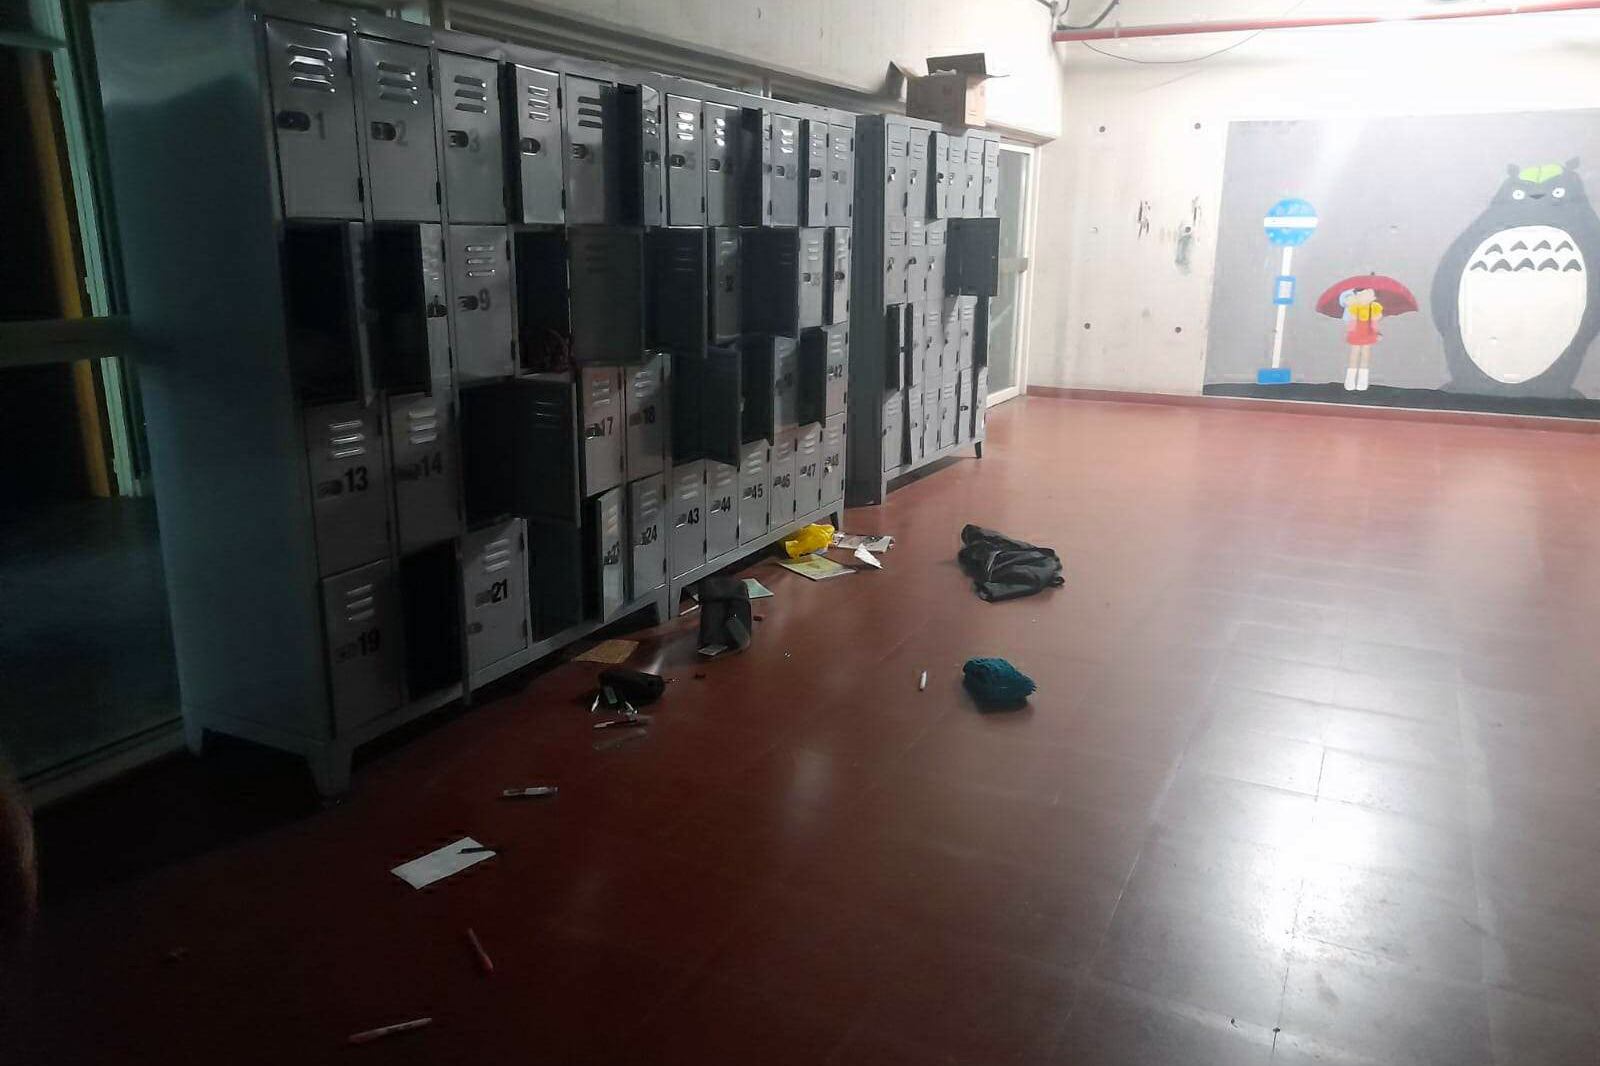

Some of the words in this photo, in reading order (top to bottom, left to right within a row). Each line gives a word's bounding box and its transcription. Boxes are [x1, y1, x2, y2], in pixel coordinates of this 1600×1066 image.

[315, 111, 326, 140] 1
[396, 119, 408, 147] 2
[479, 287, 491, 311] 9
[833, 364, 843, 379] 42
[642, 405, 656, 426] 18
[600, 416, 614, 437] 17
[421, 451, 444, 479] 14
[806, 463, 816, 478] 47
[344, 464, 369, 494] 13
[752, 483, 763, 500] 45
[720, 496, 731, 513] 44
[687, 507, 700, 526] 43
[645, 524, 658, 545] 24
[489, 578, 508, 604] 21
[357, 626, 382, 657] 19
